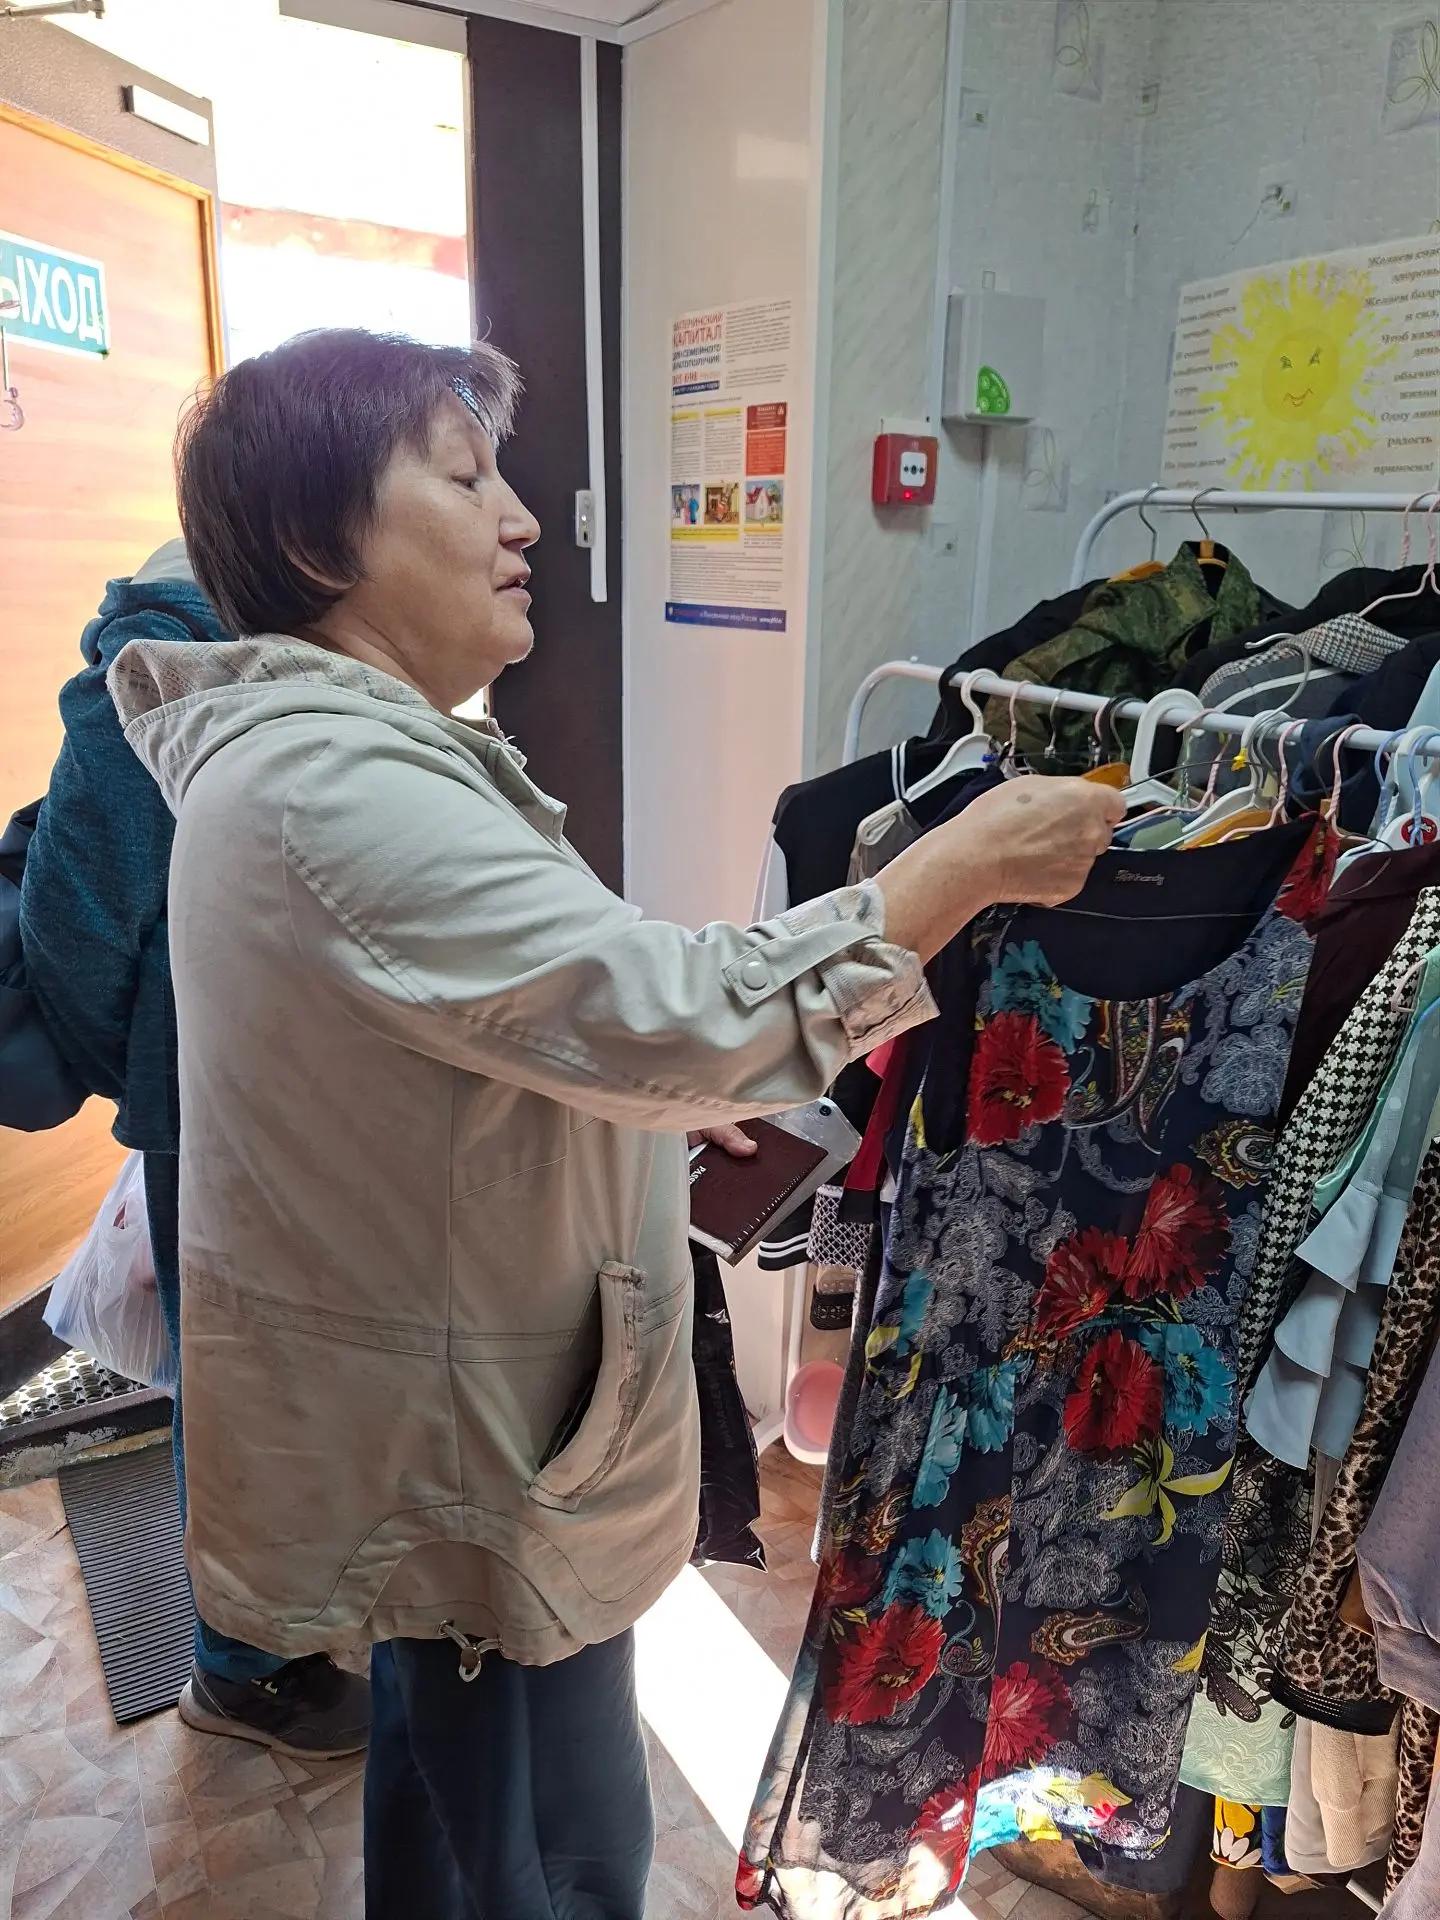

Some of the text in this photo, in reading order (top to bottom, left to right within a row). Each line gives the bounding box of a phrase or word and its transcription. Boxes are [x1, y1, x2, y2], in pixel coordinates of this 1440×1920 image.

[0, 252, 103, 345] ЫХОД
[673, 325, 722, 348] КАПИТАЛ
[689, 1165, 707, 1185] PASS
